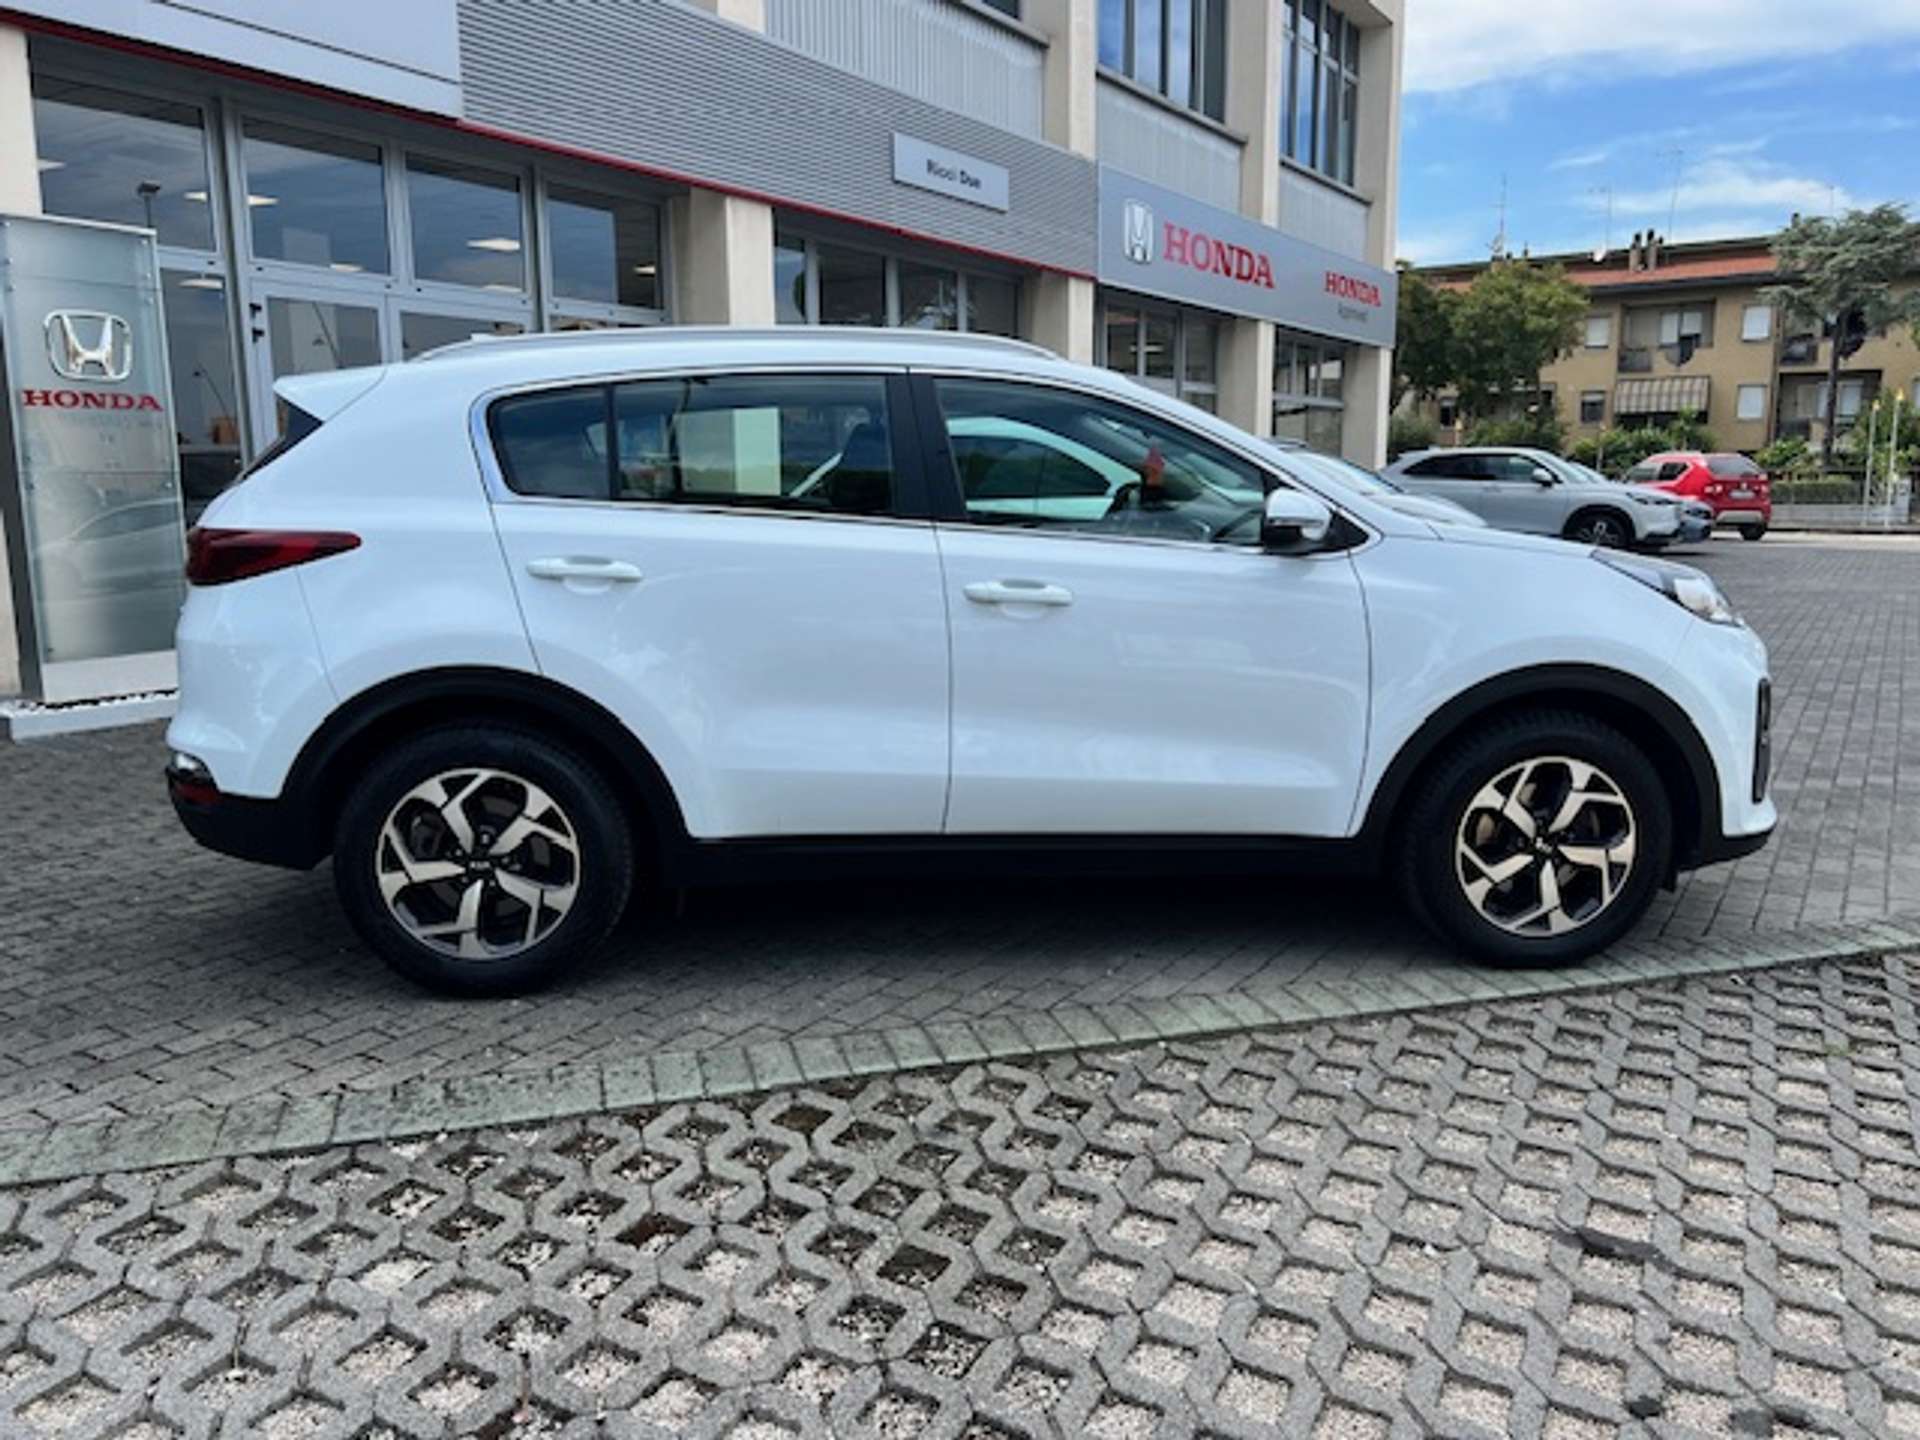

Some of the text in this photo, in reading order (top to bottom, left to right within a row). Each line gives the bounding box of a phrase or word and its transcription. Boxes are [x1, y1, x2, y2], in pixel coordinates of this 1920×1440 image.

[1163, 221, 1276, 289] HONDA
[1324, 271, 1381, 307] HONDA
[22, 389, 163, 412] HONDA
